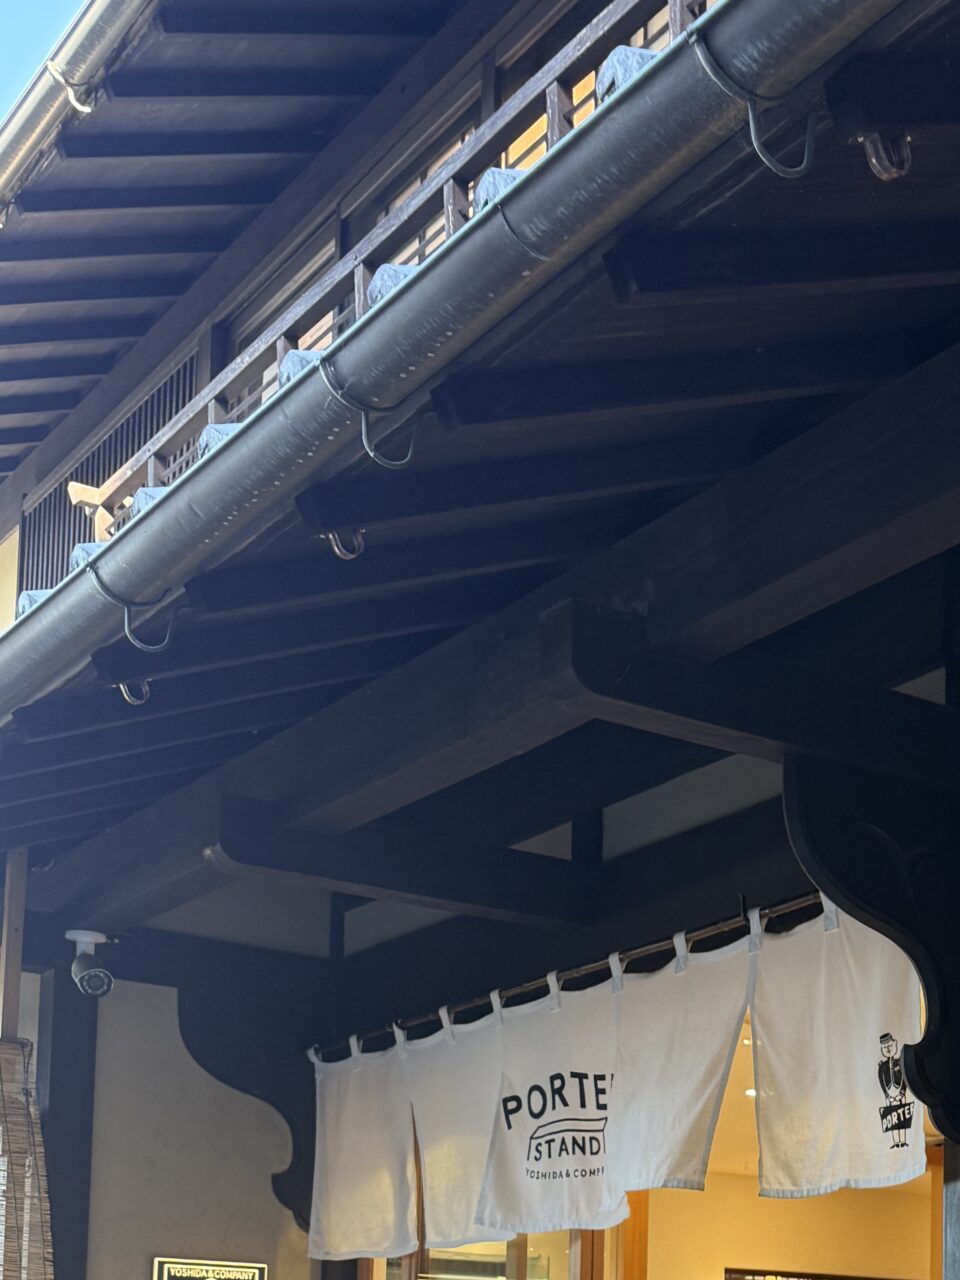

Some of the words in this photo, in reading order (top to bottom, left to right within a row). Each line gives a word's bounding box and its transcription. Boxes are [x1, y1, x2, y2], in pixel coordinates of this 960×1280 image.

[502, 1071, 614, 1130] PORTE
[534, 1135, 601, 1162] STAND
[525, 1167, 564, 1180] YOSHIDA
